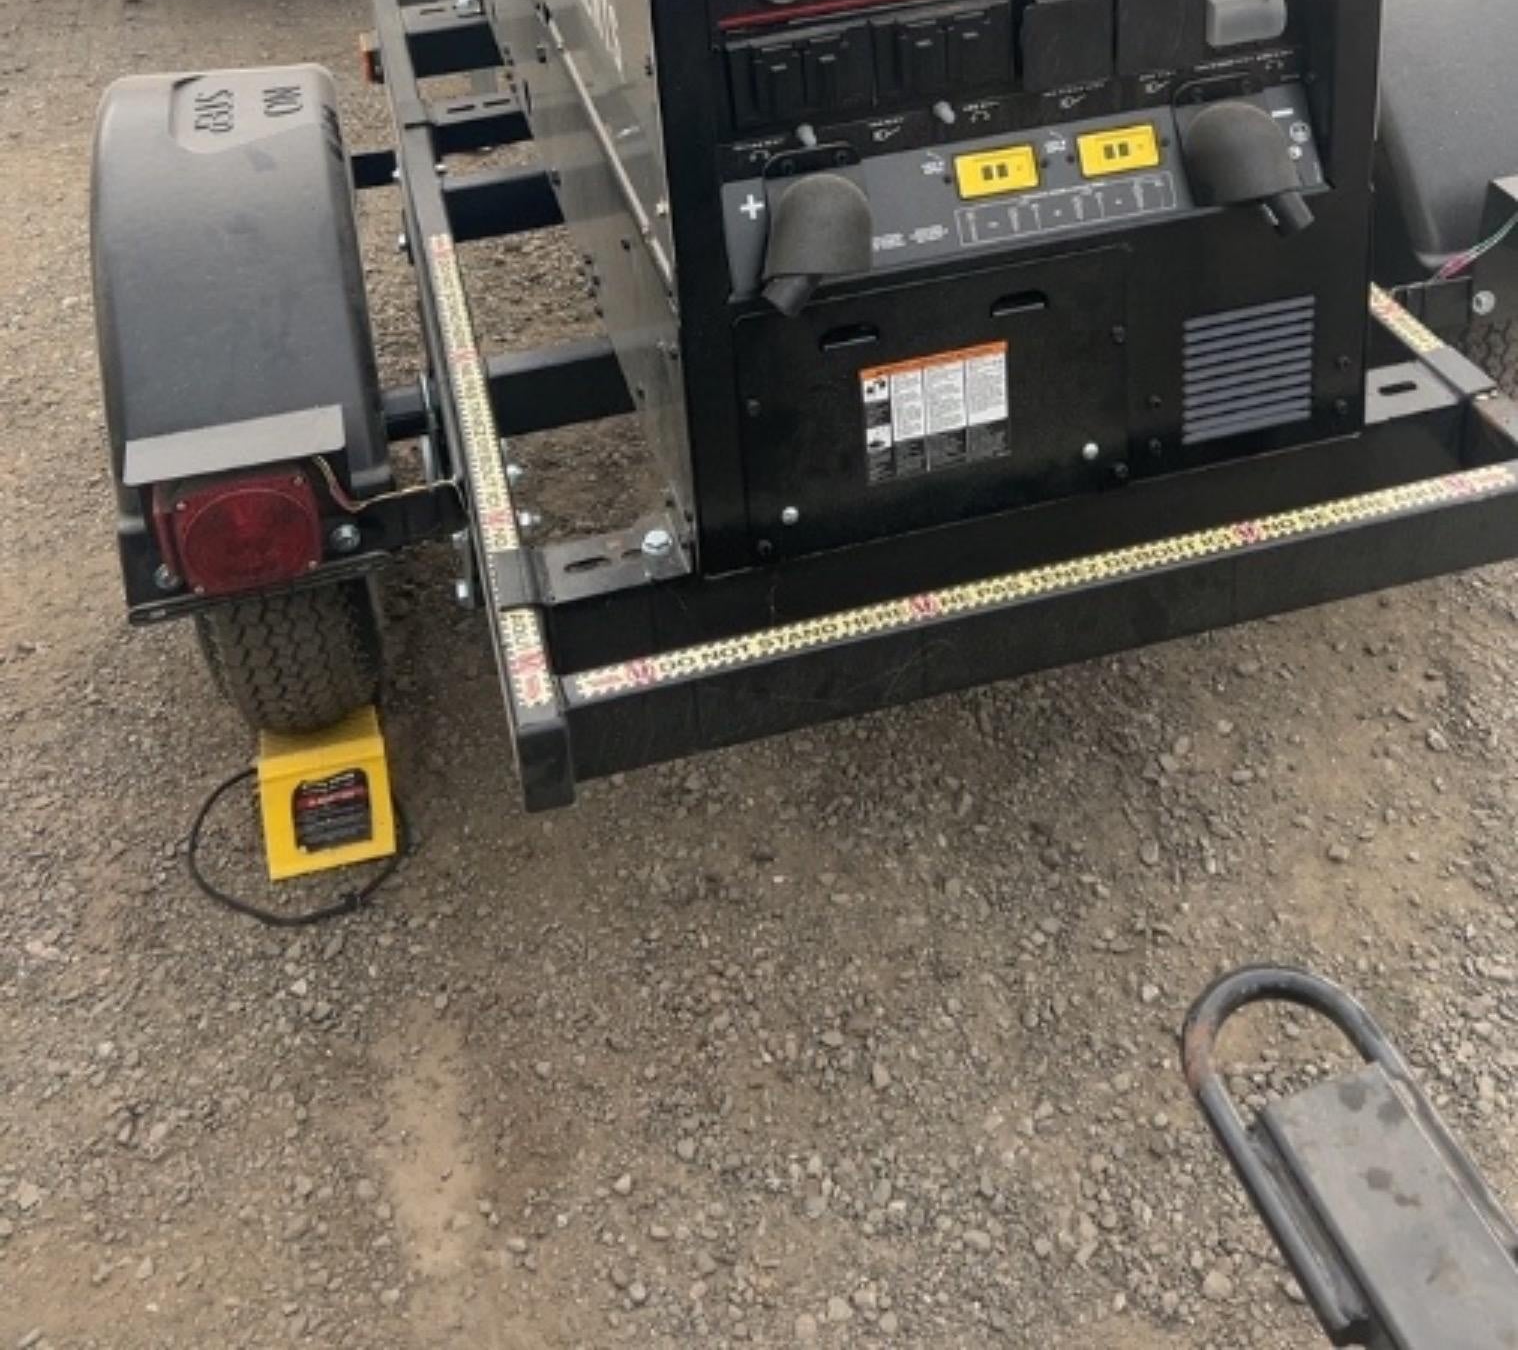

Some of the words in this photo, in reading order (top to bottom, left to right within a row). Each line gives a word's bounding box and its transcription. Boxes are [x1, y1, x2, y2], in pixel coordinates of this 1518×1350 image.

[659, 653, 697, 674] DO
[701, 642, 748, 664] NOT
[757, 622, 839, 650] STAND
